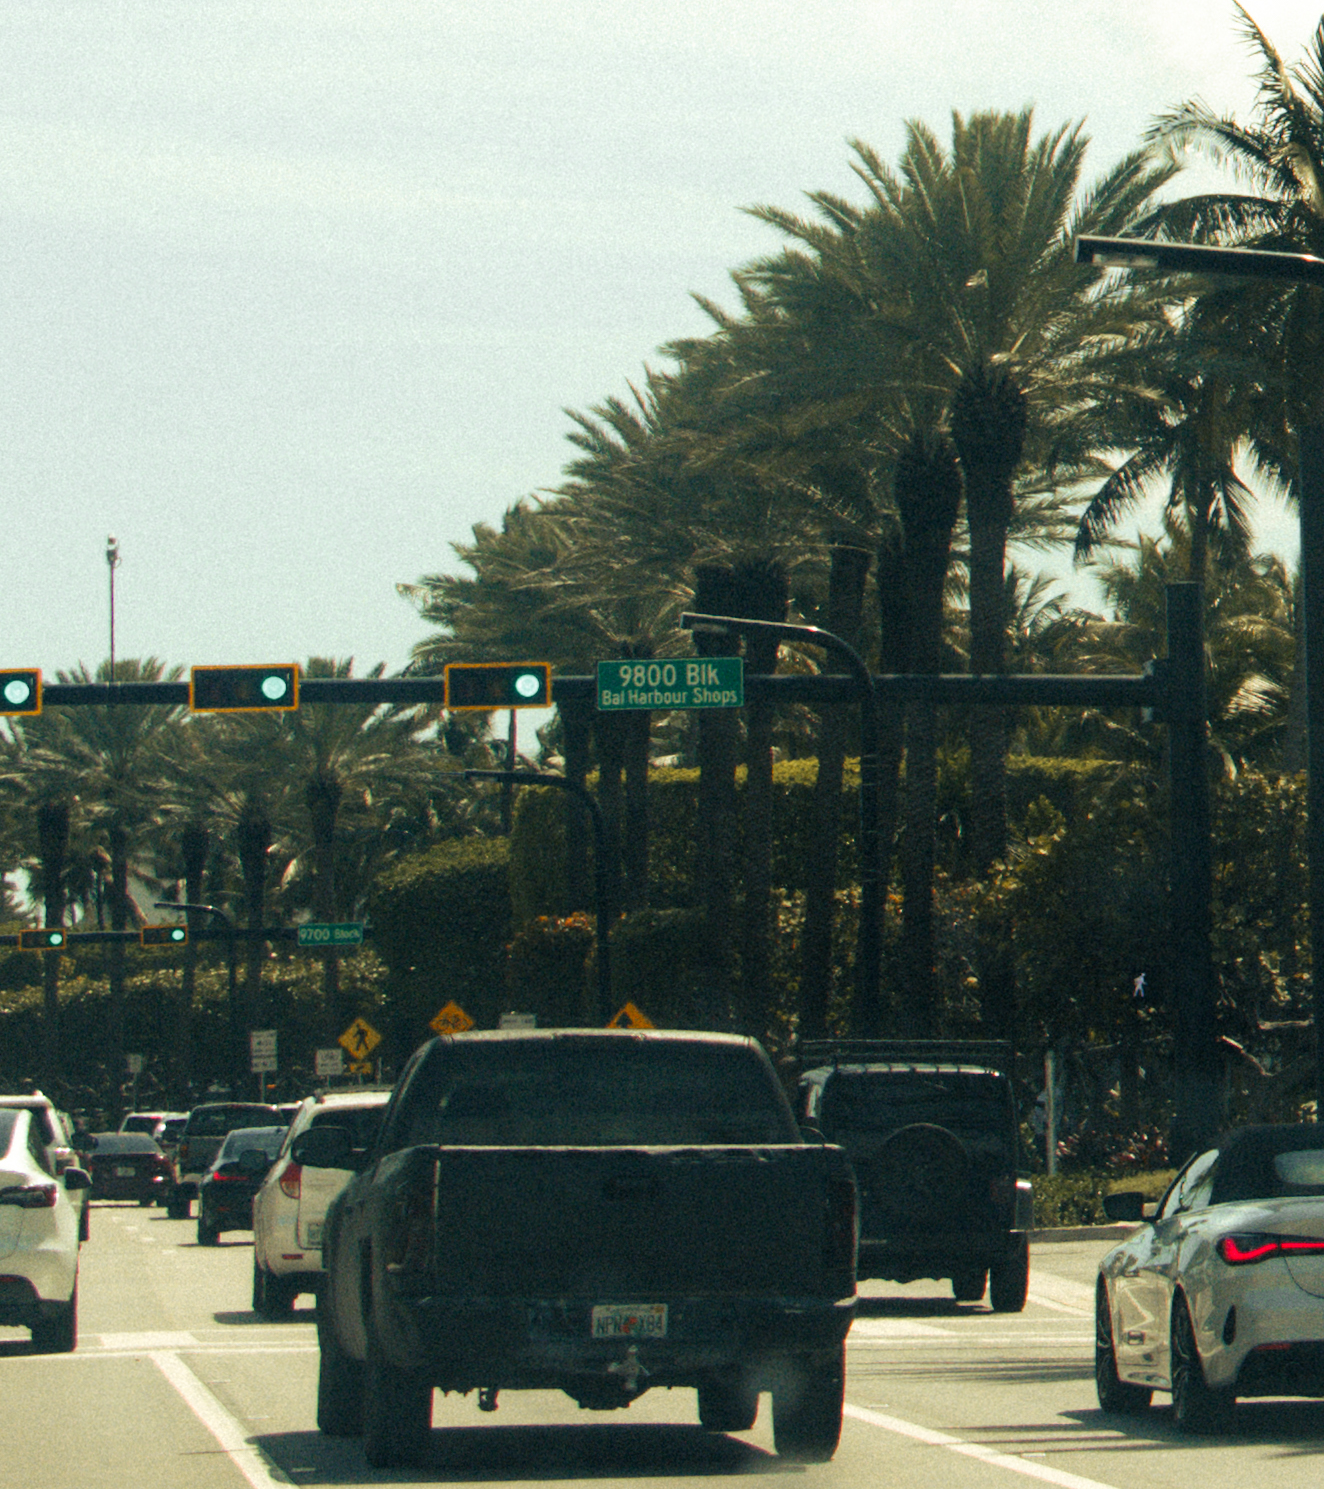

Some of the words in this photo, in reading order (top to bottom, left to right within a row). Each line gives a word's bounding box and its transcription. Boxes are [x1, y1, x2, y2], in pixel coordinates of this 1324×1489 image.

[618, 664, 677, 687] 9800
[686, 663, 720, 686] Blk
[601, 690, 625, 705] Bal
[628, 689, 688, 705] Harbour
[693, 687, 738, 707] Shops
[300, 928, 331, 940] 9700
